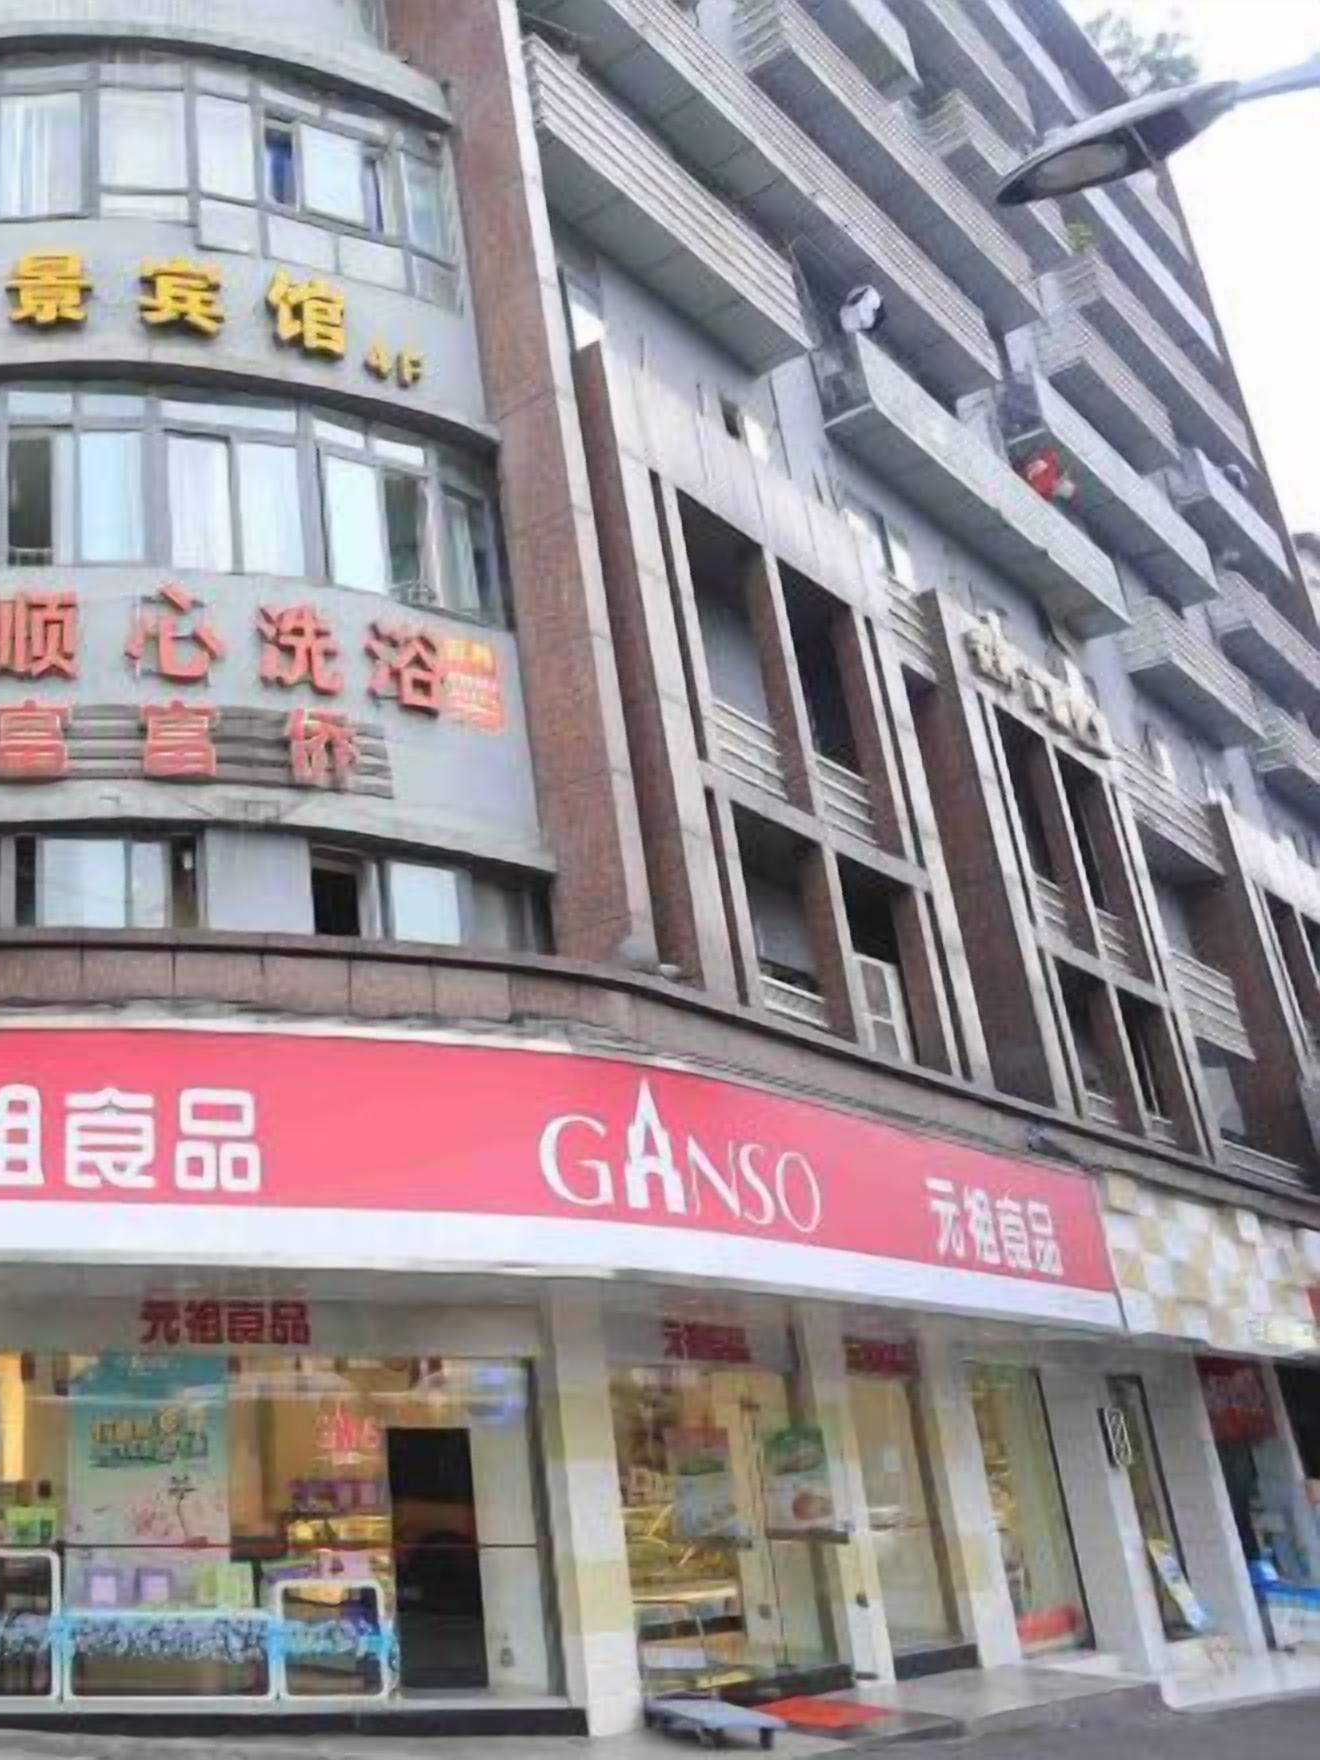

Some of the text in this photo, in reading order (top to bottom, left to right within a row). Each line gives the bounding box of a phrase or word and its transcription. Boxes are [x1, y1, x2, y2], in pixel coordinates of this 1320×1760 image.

[538, 1076, 821, 1234] GANSO
[925, 1175, 1064, 1278] 元祖食品
[139, 1298, 312, 1345] 元祖食品
